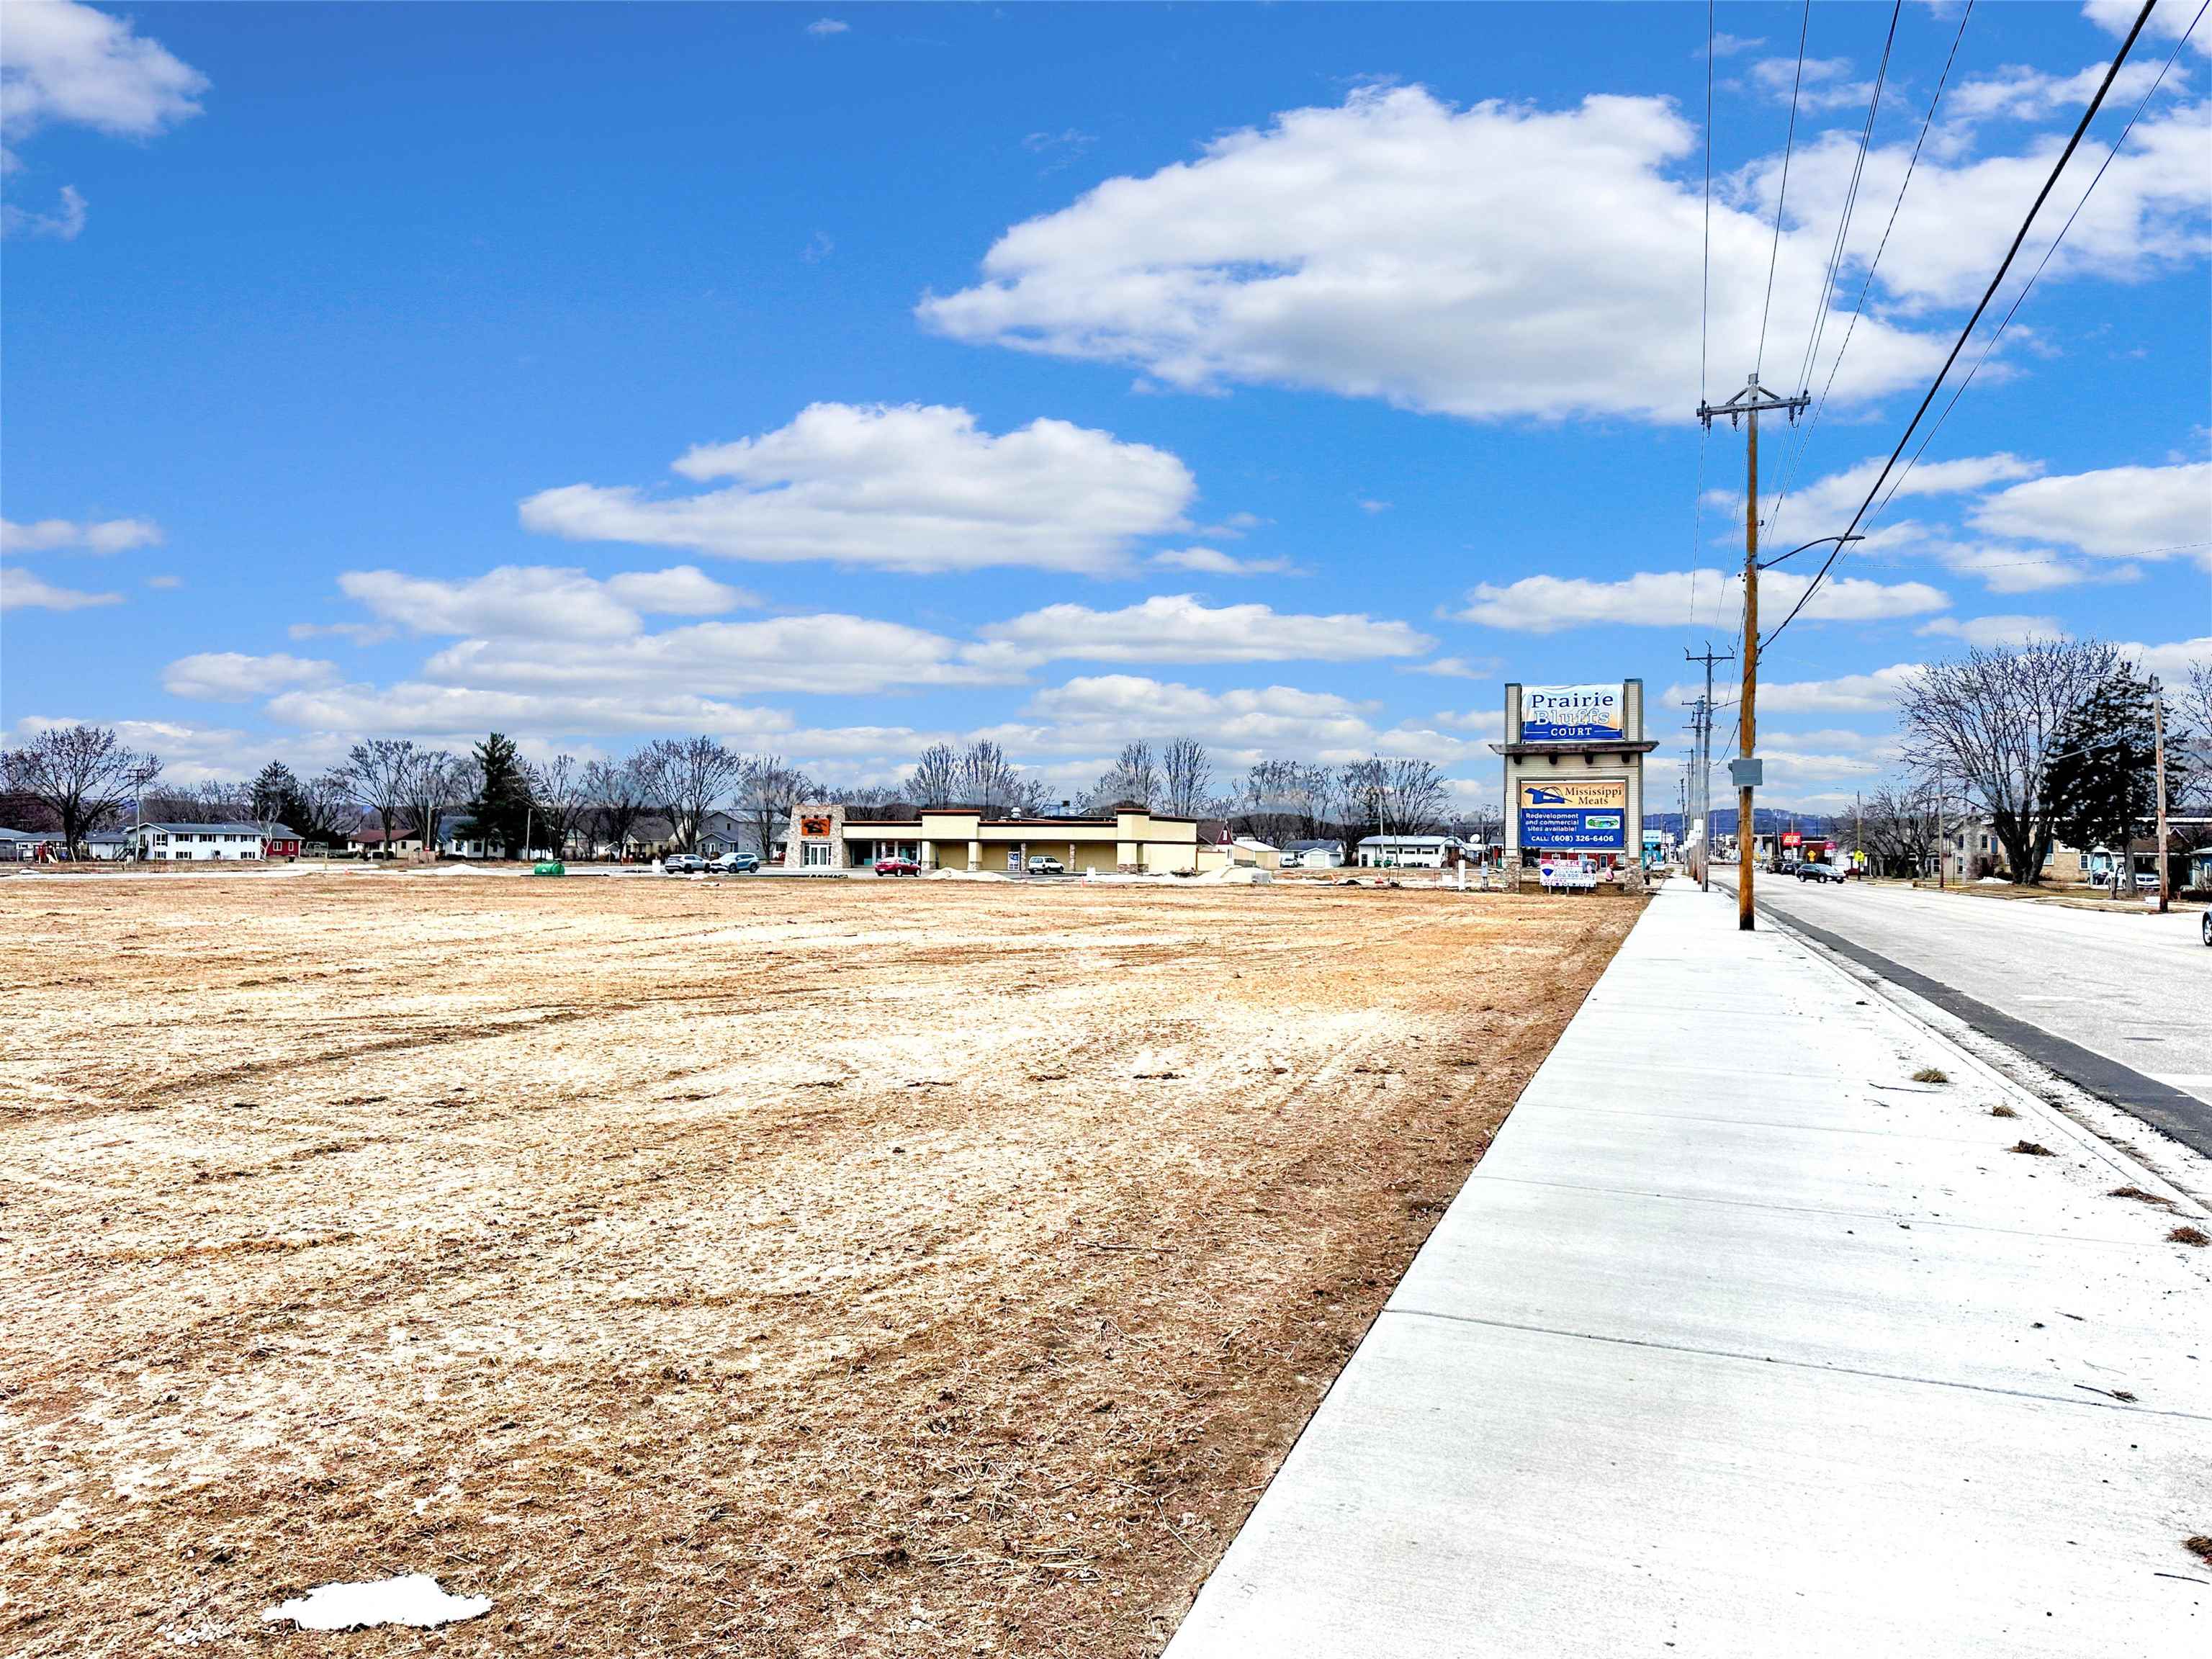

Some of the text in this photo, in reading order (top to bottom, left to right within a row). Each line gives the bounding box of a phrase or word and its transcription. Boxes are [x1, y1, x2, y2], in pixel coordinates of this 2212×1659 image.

[1532, 692, 1614, 708] Prairie
[1534, 708, 1610, 726] Bluffs
[1550, 727, 1592, 736] COURT
[1565, 787, 1622, 797] Mississippi
[1578, 796, 1609, 805] Meats
